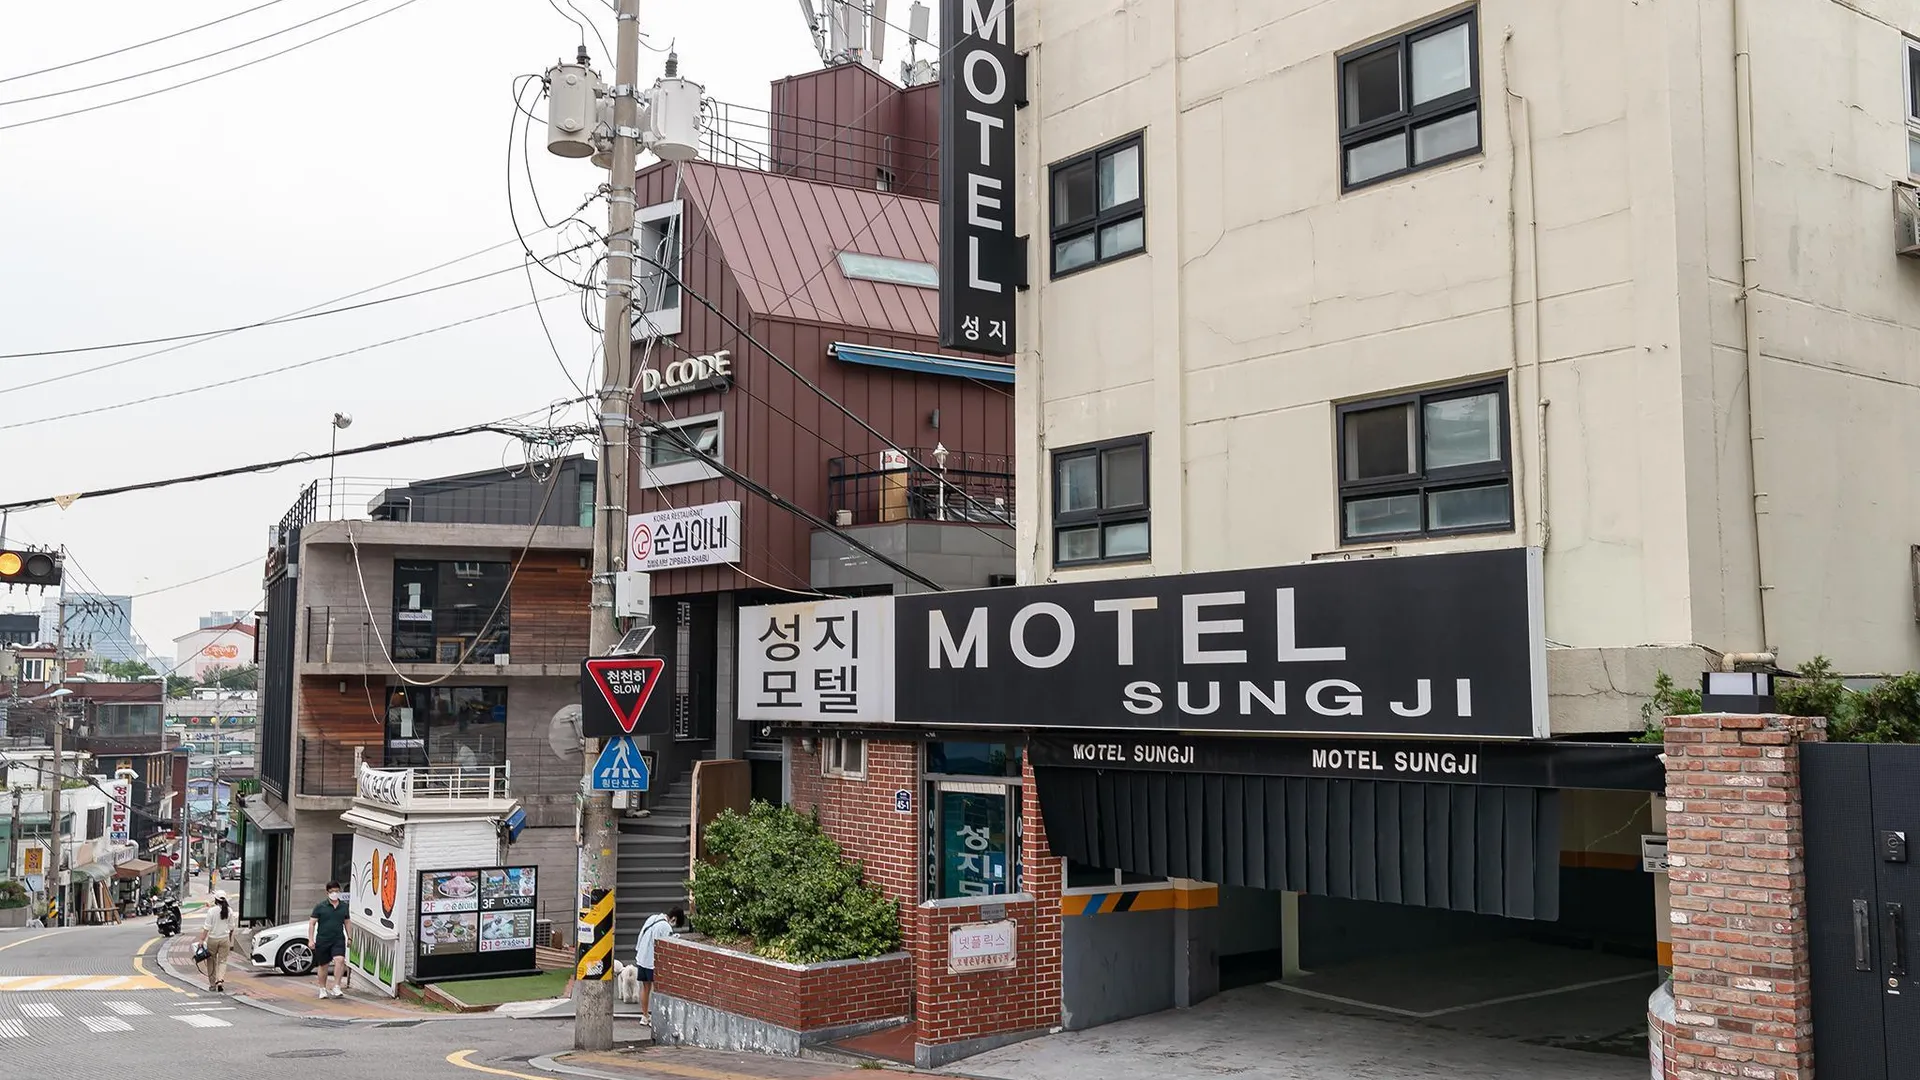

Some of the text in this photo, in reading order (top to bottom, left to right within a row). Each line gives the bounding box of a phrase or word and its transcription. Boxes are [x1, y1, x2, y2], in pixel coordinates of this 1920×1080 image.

[962, 0, 1007, 294] MOTEL
[961, 314, 1007, 346] 성지
[642, 350, 732, 393] D.CODE
[653, 513, 670, 523] KOREA
[654, 515, 728, 556] 순심이네
[758, 610, 858, 662] 성지
[928, 587, 1346, 669] MOTEL
[607, 669, 646, 684] 천천히
[613, 684, 641, 694] SLOW
[757, 665, 858, 714] 모텔
[1073, 743, 1194, 764] MOTEL SUNGJI
[1312, 749, 1477, 774] MOTEL SUNGJI
[602, 779, 640, 788] 횡단보도
[423, 901, 436, 912] 2F
[482, 898, 495, 909] 3F
[421, 943, 435, 954] 1F
[481, 941, 492, 951] B1
[959, 933, 1005, 951] 넷플릭스
